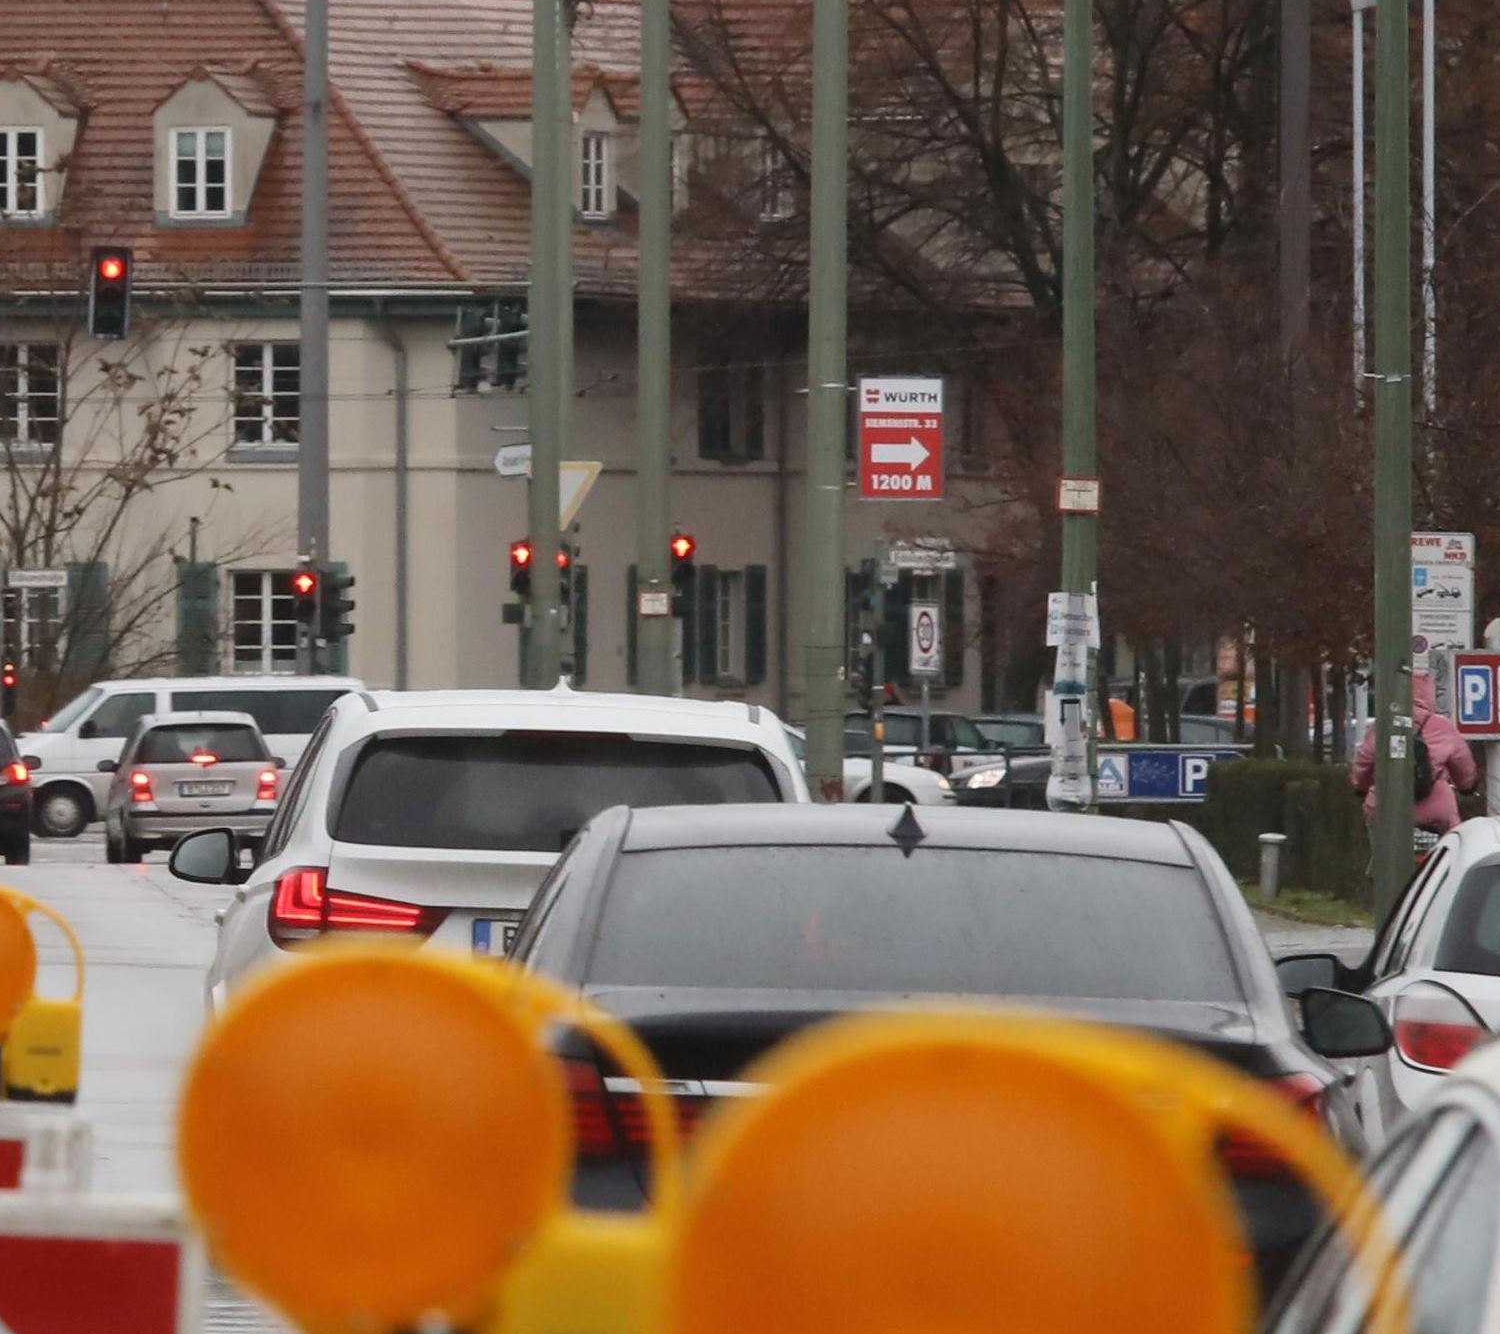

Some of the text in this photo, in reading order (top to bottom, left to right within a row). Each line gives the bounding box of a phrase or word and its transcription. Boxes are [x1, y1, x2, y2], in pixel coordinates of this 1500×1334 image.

[871, 474, 933, 491] 1200 M
[1464, 674, 1487, 716] P
